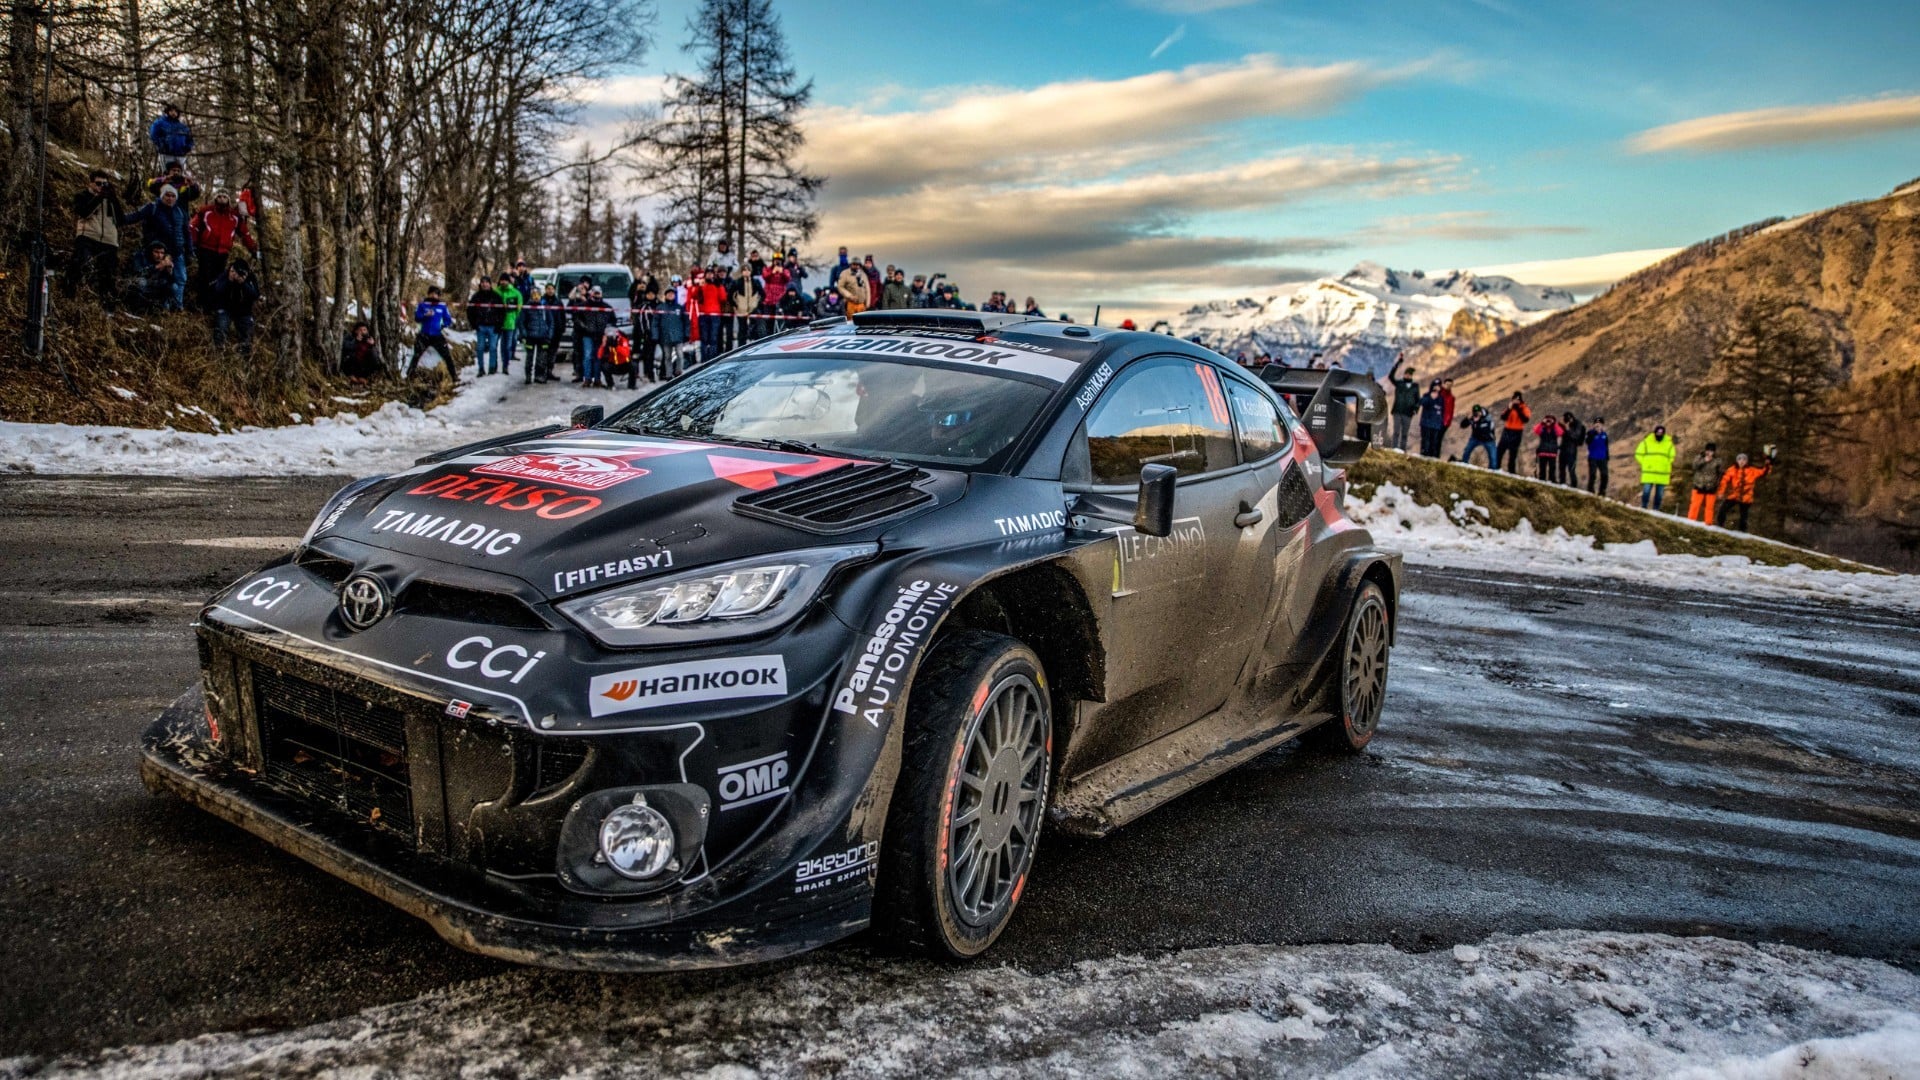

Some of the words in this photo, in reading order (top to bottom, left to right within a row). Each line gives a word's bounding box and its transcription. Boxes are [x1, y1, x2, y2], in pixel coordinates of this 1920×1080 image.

[976, 335, 1054, 353] Racing
[1075, 361, 1114, 411] AsahiKASEI
[1195, 363, 1230, 425] 18
[407, 473, 604, 520] DENSO
[372, 510, 521, 556] TAMADIC
[994, 509, 1066, 536] TAMADIC
[1123, 535, 1142, 563] LE
[1144, 526, 1202, 559] CASINO
[833, 580, 931, 715] Panasonic
[863, 582, 959, 728] AUTOMOTIVE
[718, 758, 789, 800] OMP
[794, 878, 832, 894] BRAKE
